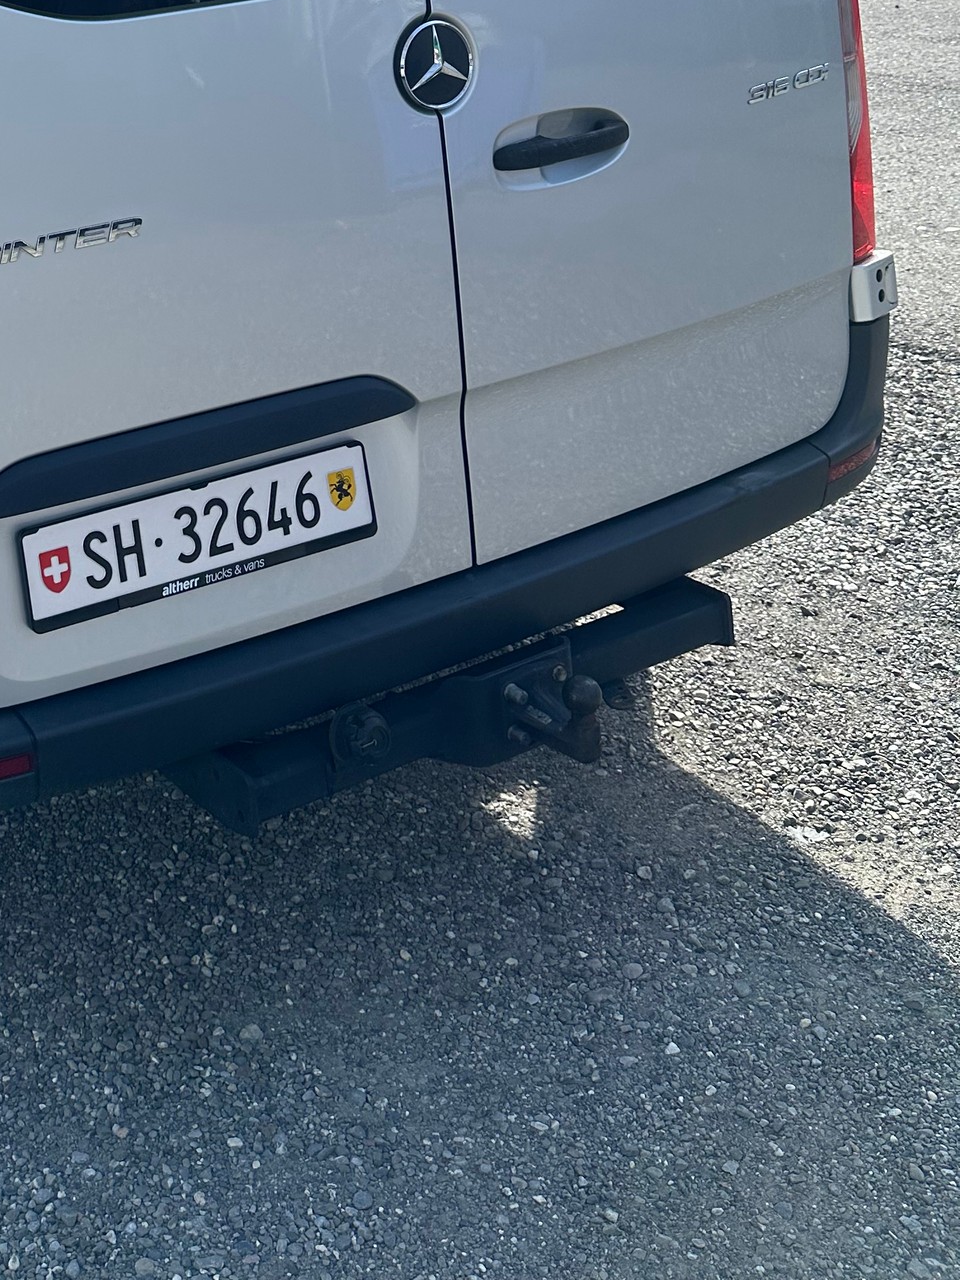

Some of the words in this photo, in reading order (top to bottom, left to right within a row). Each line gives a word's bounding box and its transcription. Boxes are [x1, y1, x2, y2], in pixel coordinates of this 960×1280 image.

[747, 76, 790, 105] 316
[162, 577, 200, 597] altherr
[205, 568, 233, 584] trucks
[234, 564, 242, 575] &
[243, 558, 266, 572] vans
